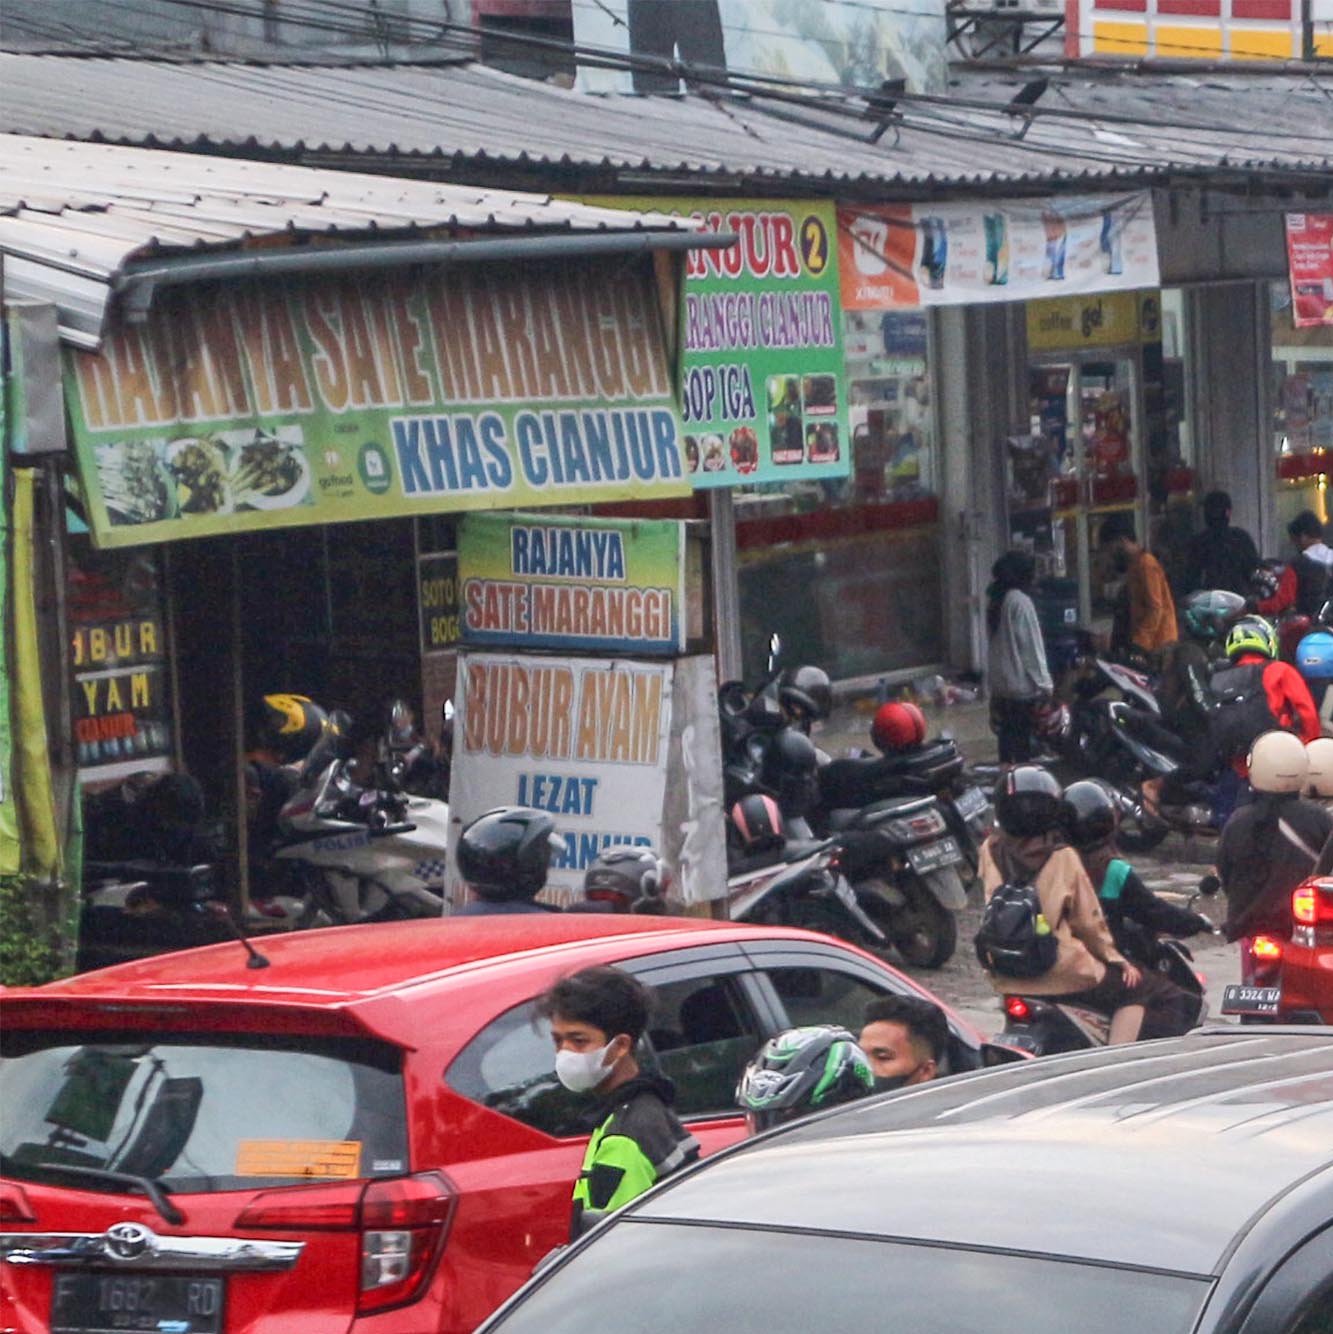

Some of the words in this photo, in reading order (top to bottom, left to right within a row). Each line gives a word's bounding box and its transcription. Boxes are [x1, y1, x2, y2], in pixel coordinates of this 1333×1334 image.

[806, 222, 823, 270] 2
[718, 364, 757, 419] IGA
[392, 413, 512, 494] KHAS
[516, 410, 682, 487] CIANJUR
[513, 529, 625, 579] RAJANYA
[465, 582, 529, 632] SATE
[531, 585, 672, 641] MARANGGI
[465, 662, 573, 760] BUBUR
[576, 669, 664, 765] AYAM
[517, 774, 598, 815] LEZAT
